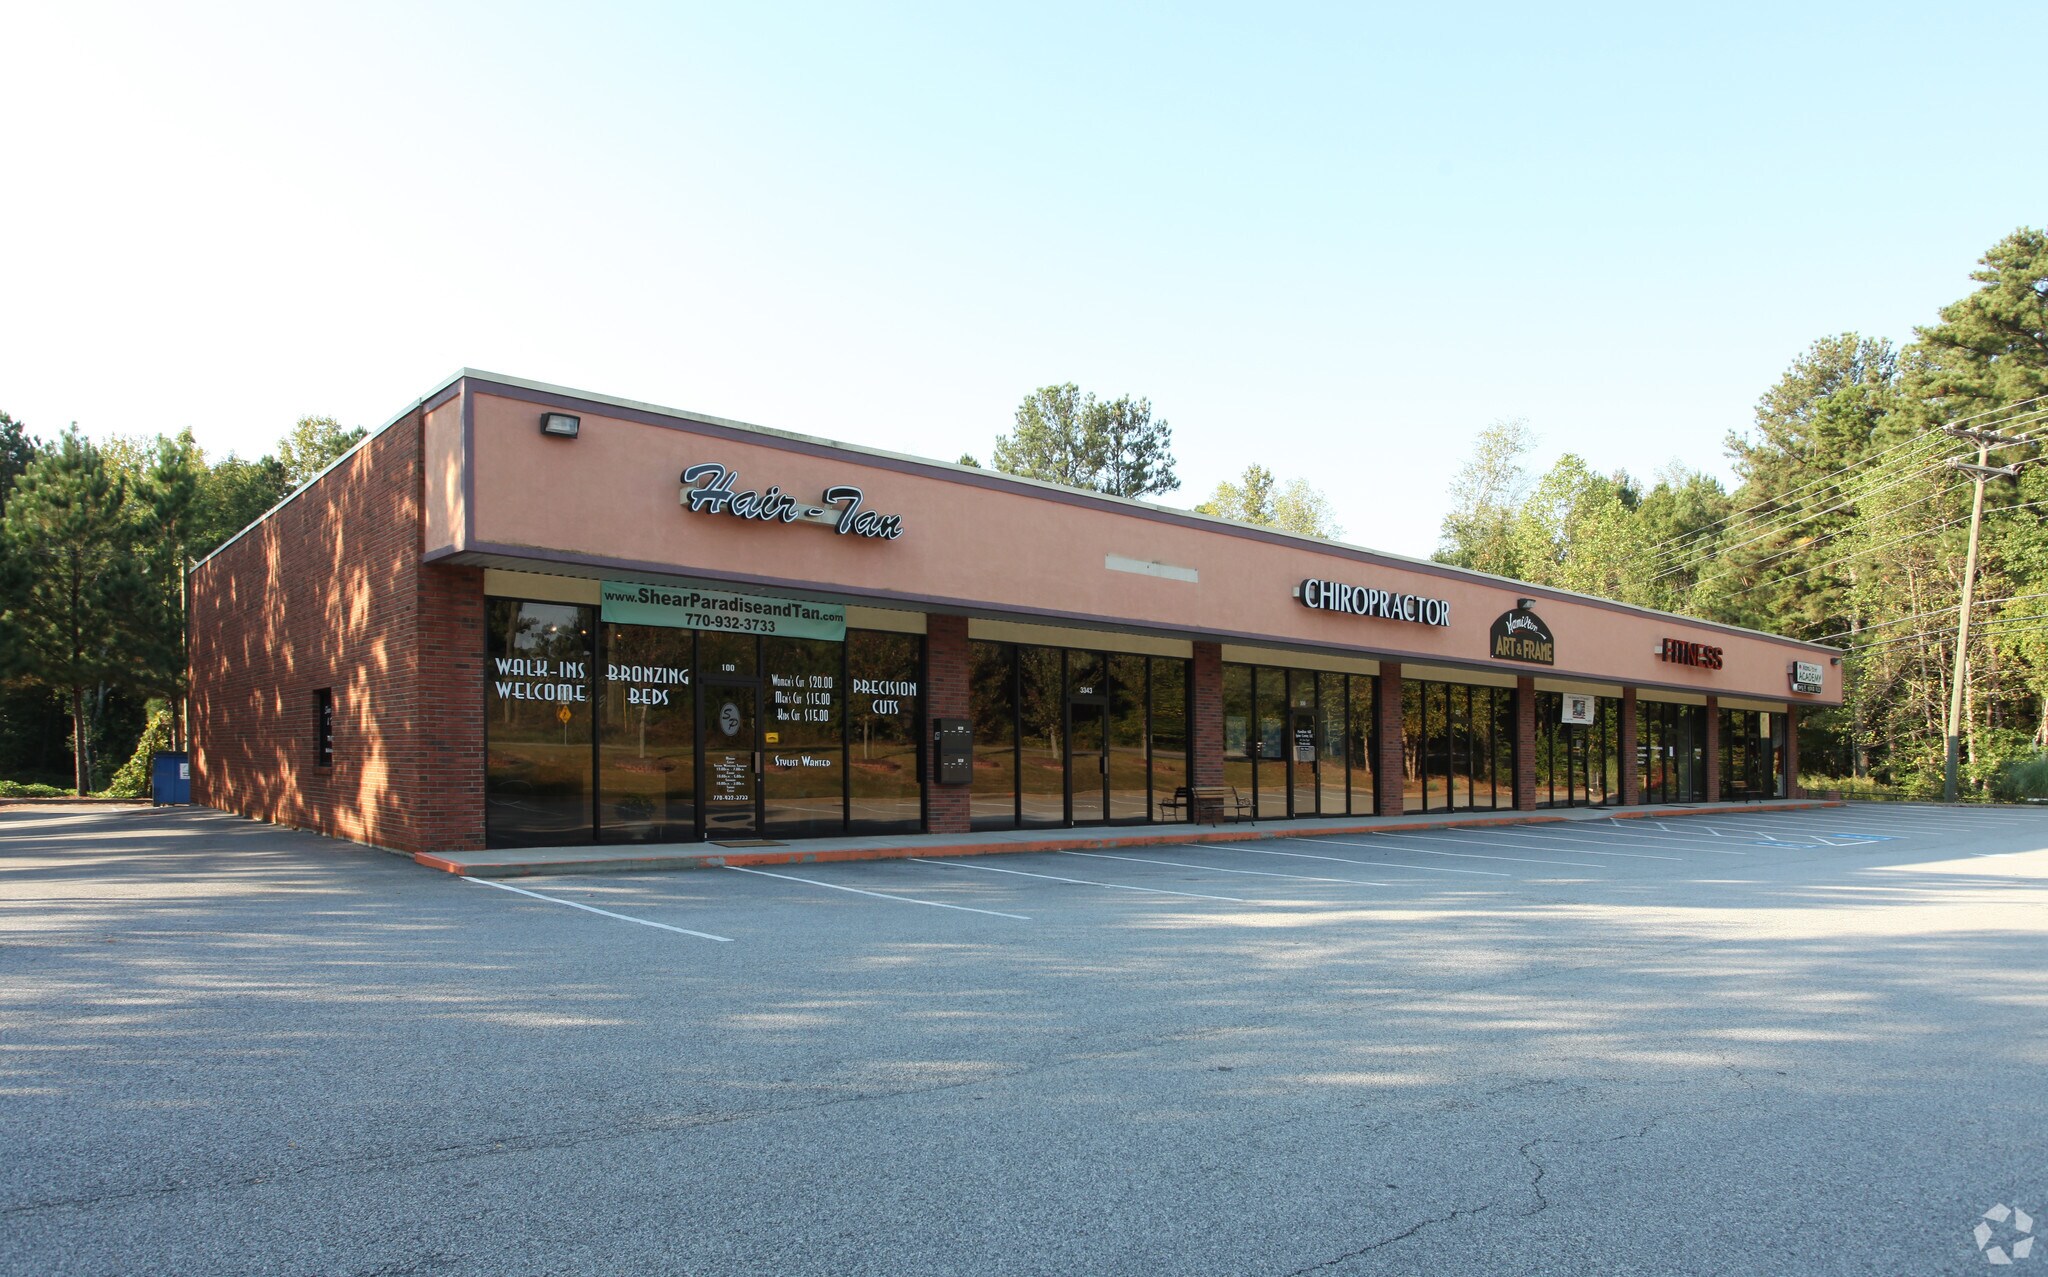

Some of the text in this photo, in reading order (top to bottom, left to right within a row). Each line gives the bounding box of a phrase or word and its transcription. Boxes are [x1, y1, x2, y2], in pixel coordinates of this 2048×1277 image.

[681, 462, 799, 522] Hair
[822, 485, 904, 540] Tan
[604, 587, 844, 622] www.ShearParadiseandTan.com
[1302, 578, 1450, 627] CHIROPRACTOR
[685, 613, 776, 632] 770-932-3733
[1505, 613, 1544, 637] Hamilton
[1496, 634, 1553, 661] ART & FRAME
[1662, 638, 1723, 670] FITNESS
[495, 657, 585, 679] WALK-INS
[605, 664, 689, 685] BRONZING
[722, 663, 735, 672] 100
[495, 681, 586, 702] WELCOME
[809, 675, 833, 689] $20.00
[853, 678, 917, 696] PRECISION
[1080, 686, 1093, 694] 3343
[627, 687, 669, 706] BEDS
[806, 691, 830, 705] $15.00
[804, 709, 829, 722] $15.00
[872, 699, 899, 715] CUTS
